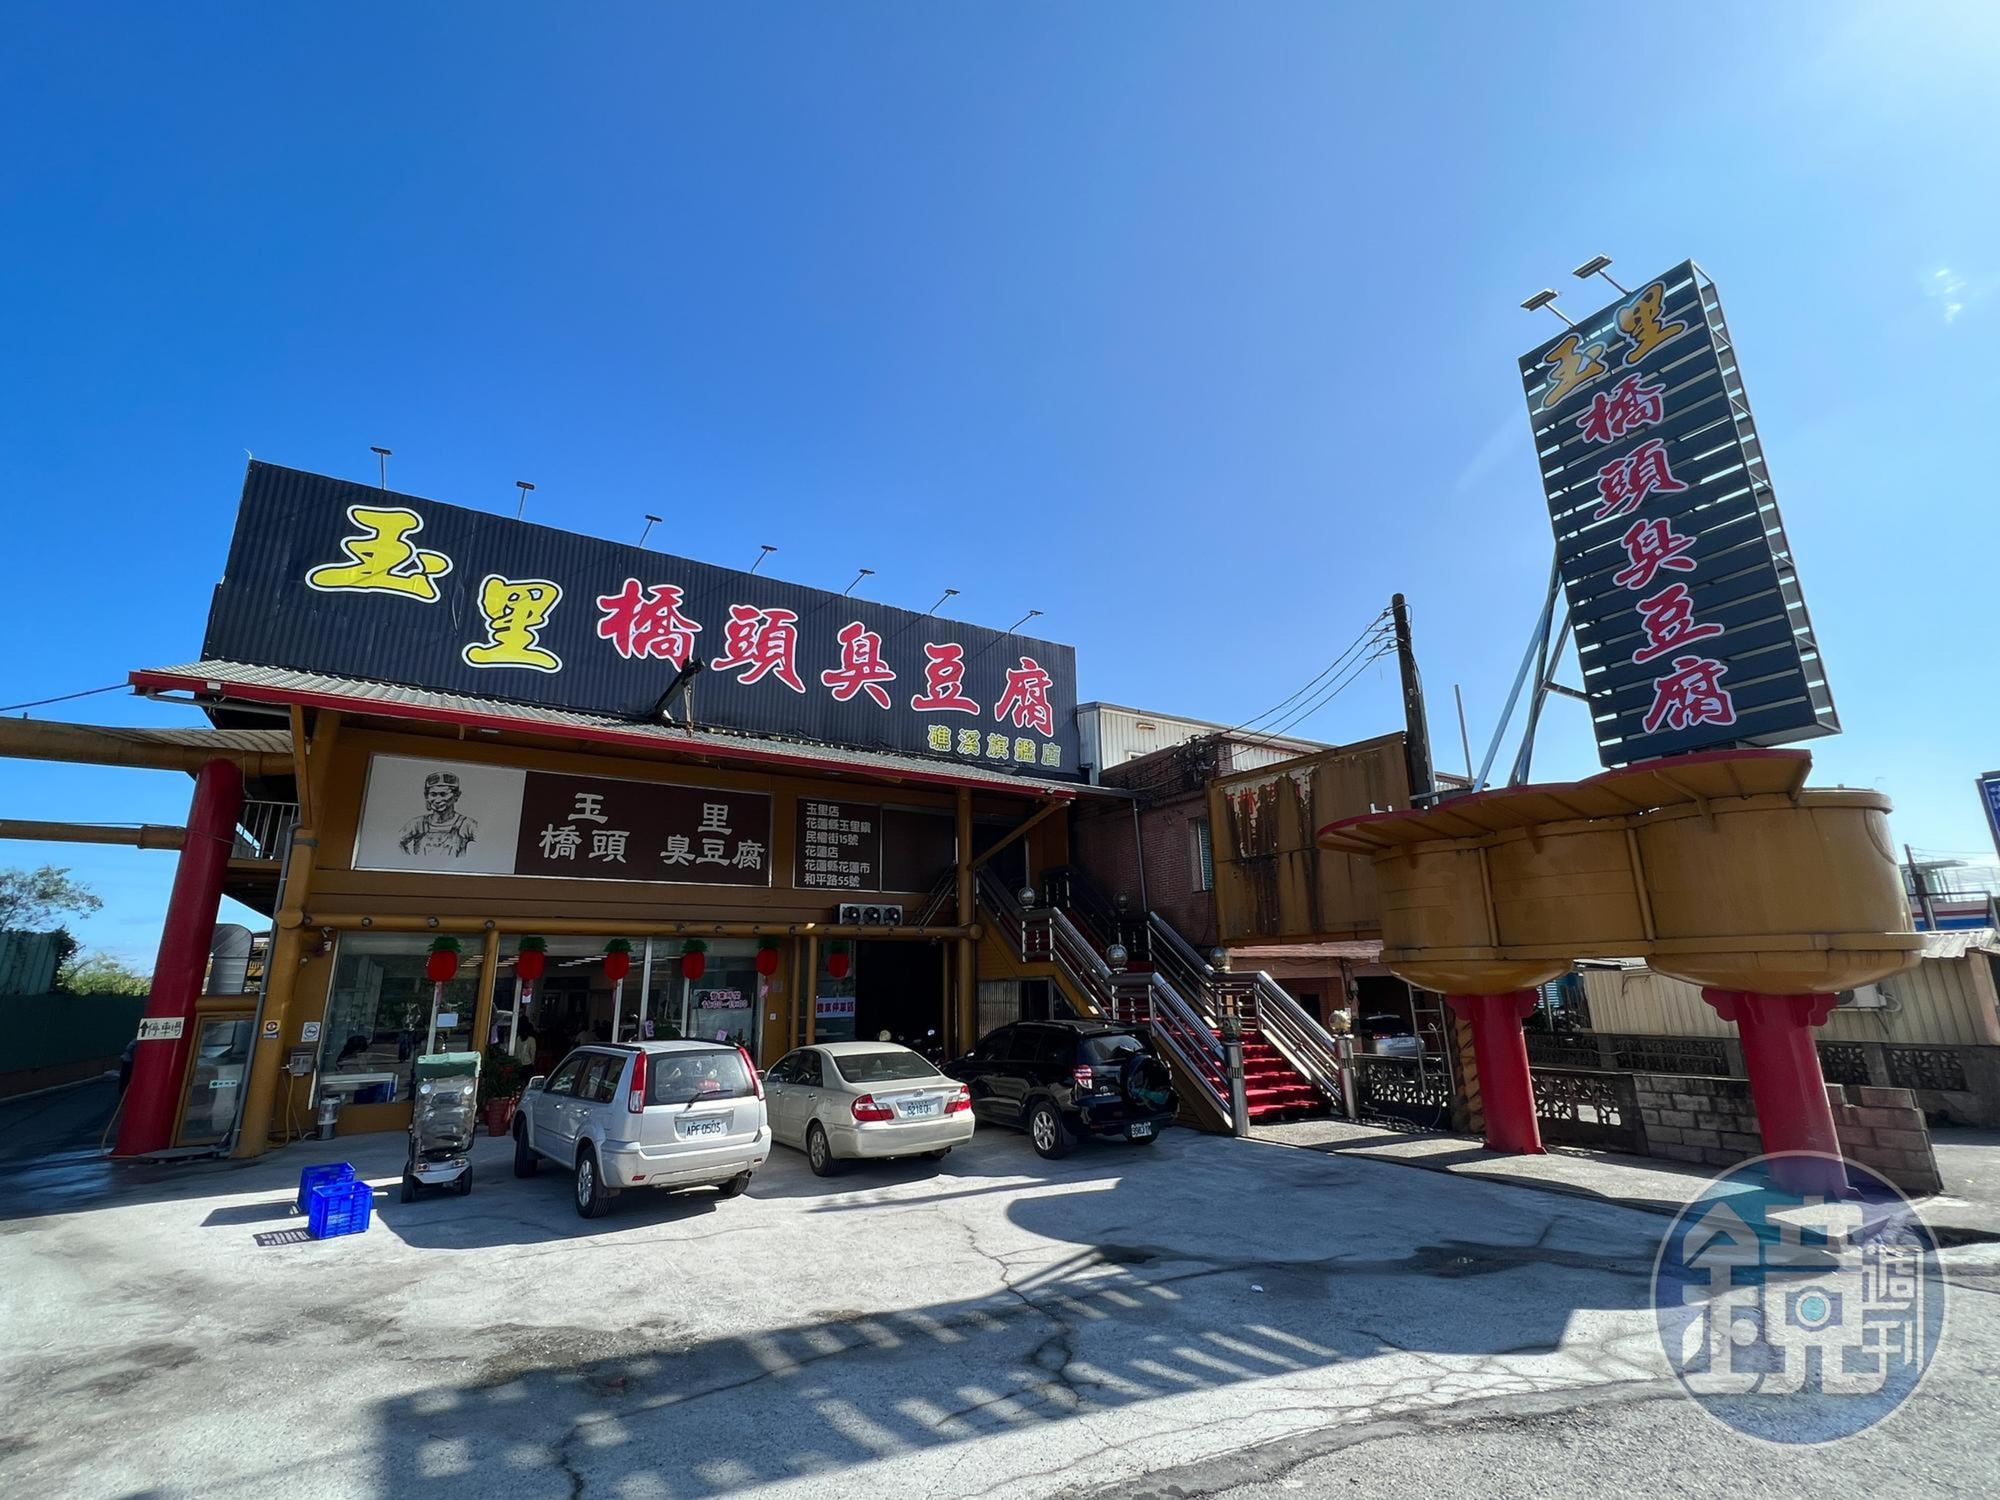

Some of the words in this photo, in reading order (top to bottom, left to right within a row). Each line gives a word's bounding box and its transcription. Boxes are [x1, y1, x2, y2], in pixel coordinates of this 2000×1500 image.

[1577, 373, 1737, 733] 橋頭臭豆腐
[927, 725, 1061, 767] 礁溪旗艦店
[806, 803, 839, 817] 玉里店
[805, 817, 871, 833] 花蓮縣玉里鎮
[805, 845, 838, 859] 花蓮店
[804, 859, 870, 874] 花蓮縣花蓮市
